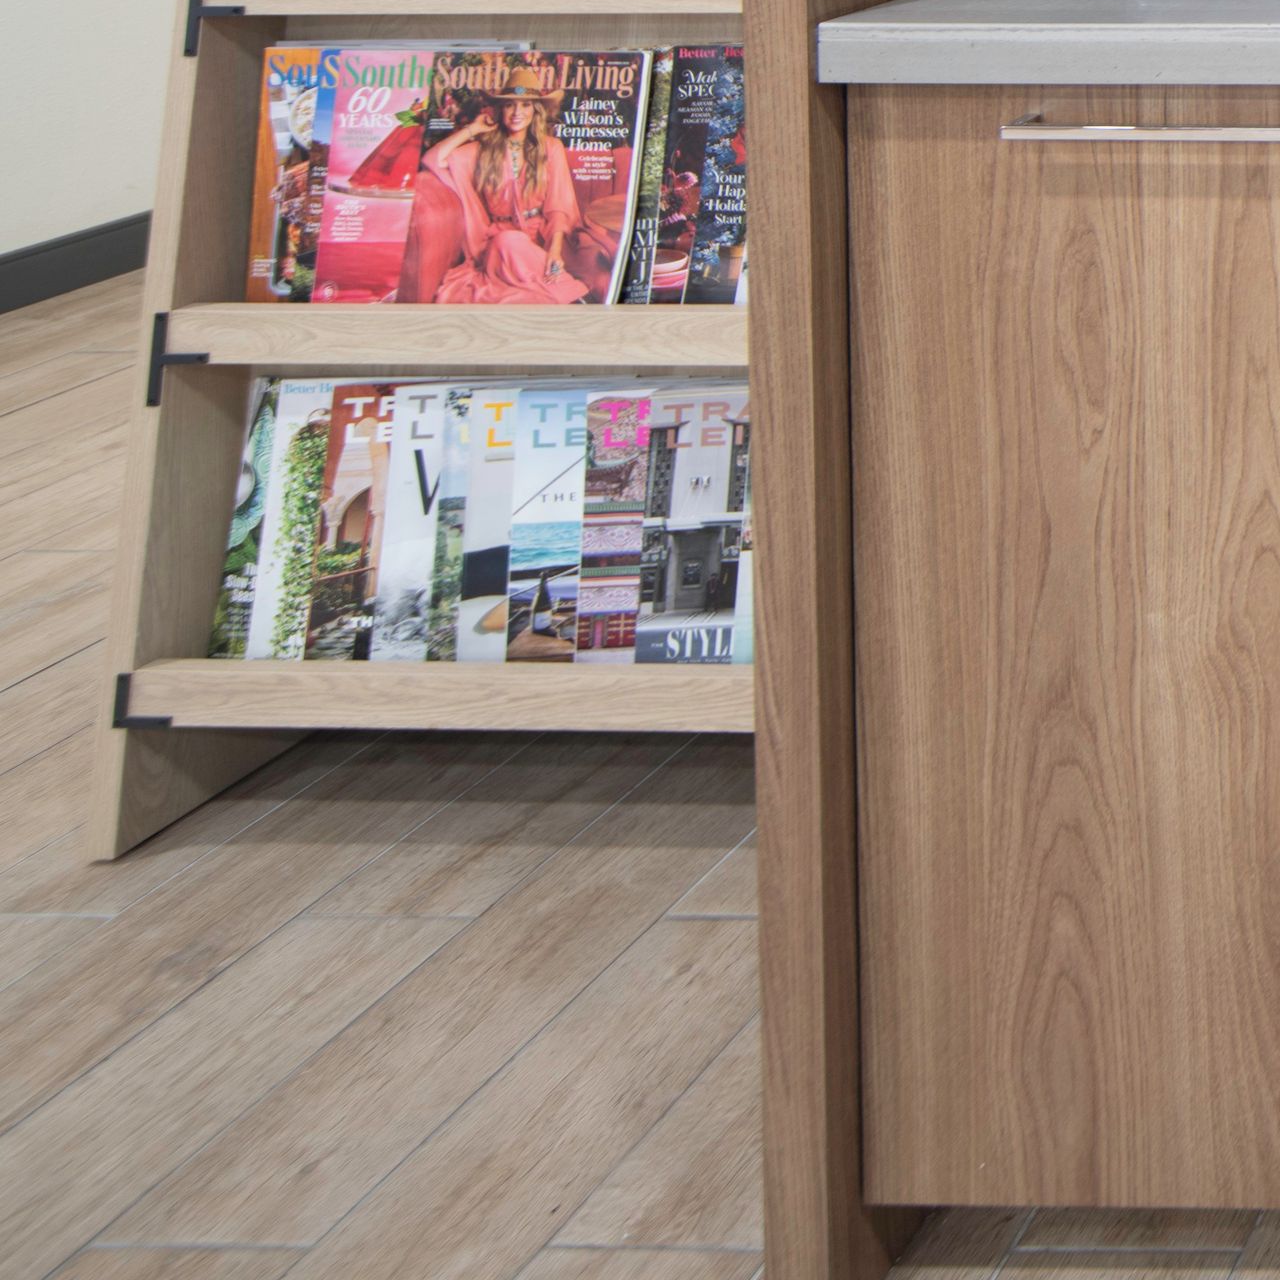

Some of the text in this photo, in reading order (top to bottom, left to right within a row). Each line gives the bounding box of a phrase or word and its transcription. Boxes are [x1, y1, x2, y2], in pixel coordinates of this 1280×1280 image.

[561, 56, 634, 98] Living
[347, 86, 391, 113] 60
[571, 96, 618, 114] Lainey
[339, 113, 393, 128] YEARS
[564, 111, 623, 126] Wilson's
[554, 123, 629, 138] Tennessee
[568, 138, 612, 152] Home
[711, 169, 745, 184] Your
[715, 214, 742, 225] Start
[540, 492, 577, 503] THE
